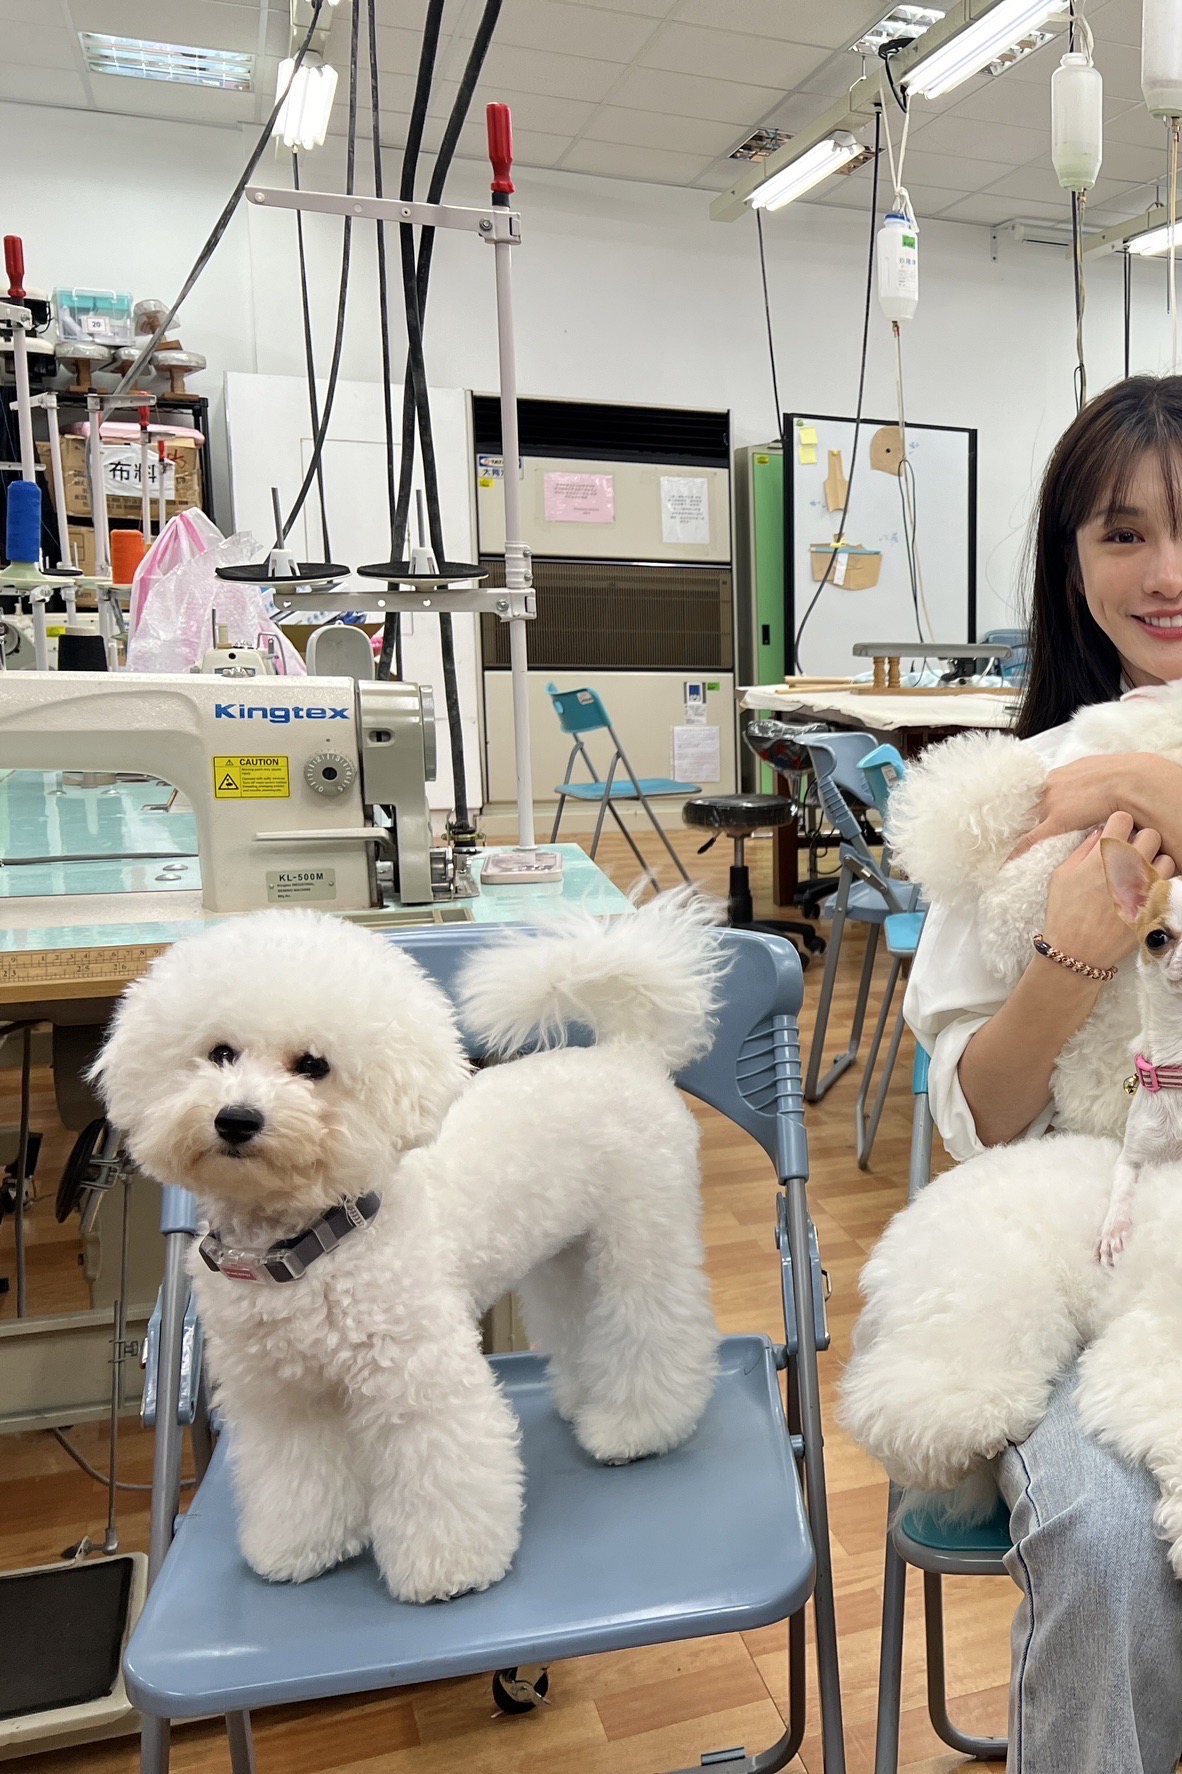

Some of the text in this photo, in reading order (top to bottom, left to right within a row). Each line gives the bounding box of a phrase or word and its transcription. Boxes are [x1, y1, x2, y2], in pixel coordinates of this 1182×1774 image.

[109, 461, 157, 483] 布料
[215, 703, 350, 724] Kingtex
[279, 873, 323, 881] KL-500M
